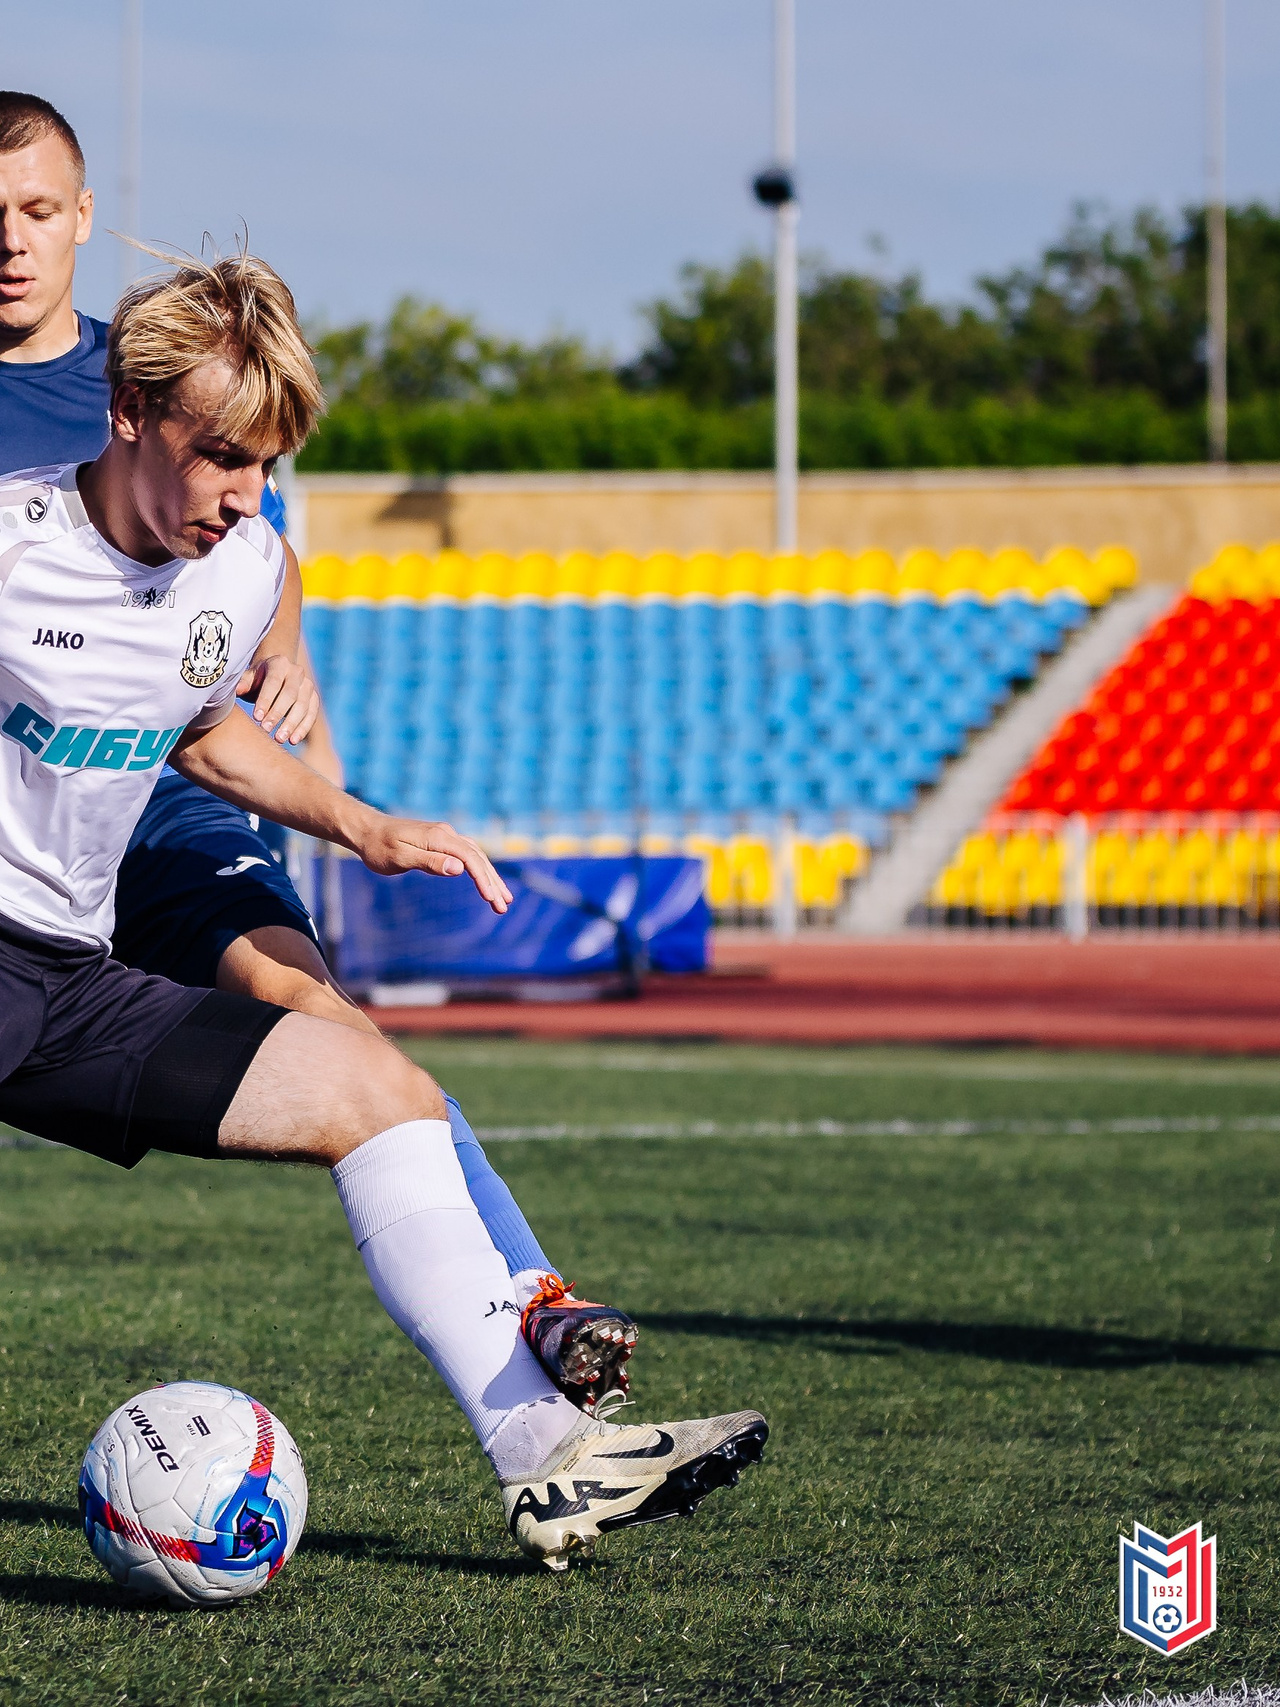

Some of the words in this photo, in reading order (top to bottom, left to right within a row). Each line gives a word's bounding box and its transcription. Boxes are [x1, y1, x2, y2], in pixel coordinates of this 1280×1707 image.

[121, 590, 176, 609] 1961
[32, 628, 85, 650] JAKO
[125, 1404, 180, 1473] DEMIX
